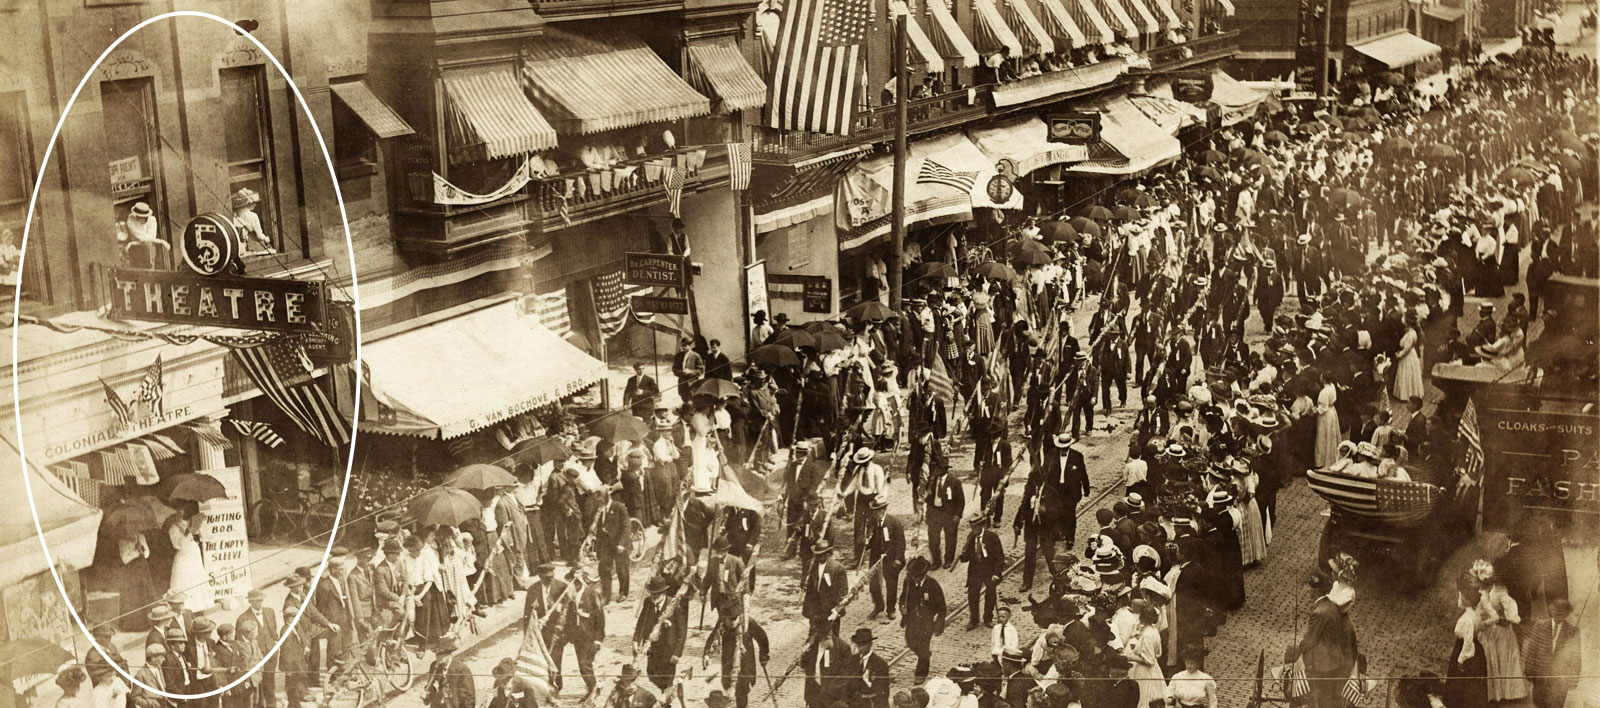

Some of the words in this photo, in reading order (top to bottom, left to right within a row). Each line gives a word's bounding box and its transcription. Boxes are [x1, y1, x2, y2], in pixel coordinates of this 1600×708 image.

[116, 280, 307, 324] THEATRE
[485, 409, 503, 423] VAN
[507, 393, 548, 415] BOCHOVE
[1497, 421, 1546, 432] CLOAKS
[1557, 424, 1592, 435] SUITS
[44, 429, 116, 459] COLONIAL
[204, 512, 242, 524] IGHTING
[205, 541, 216, 551] THE
[219, 540, 244, 550] EMPTY
